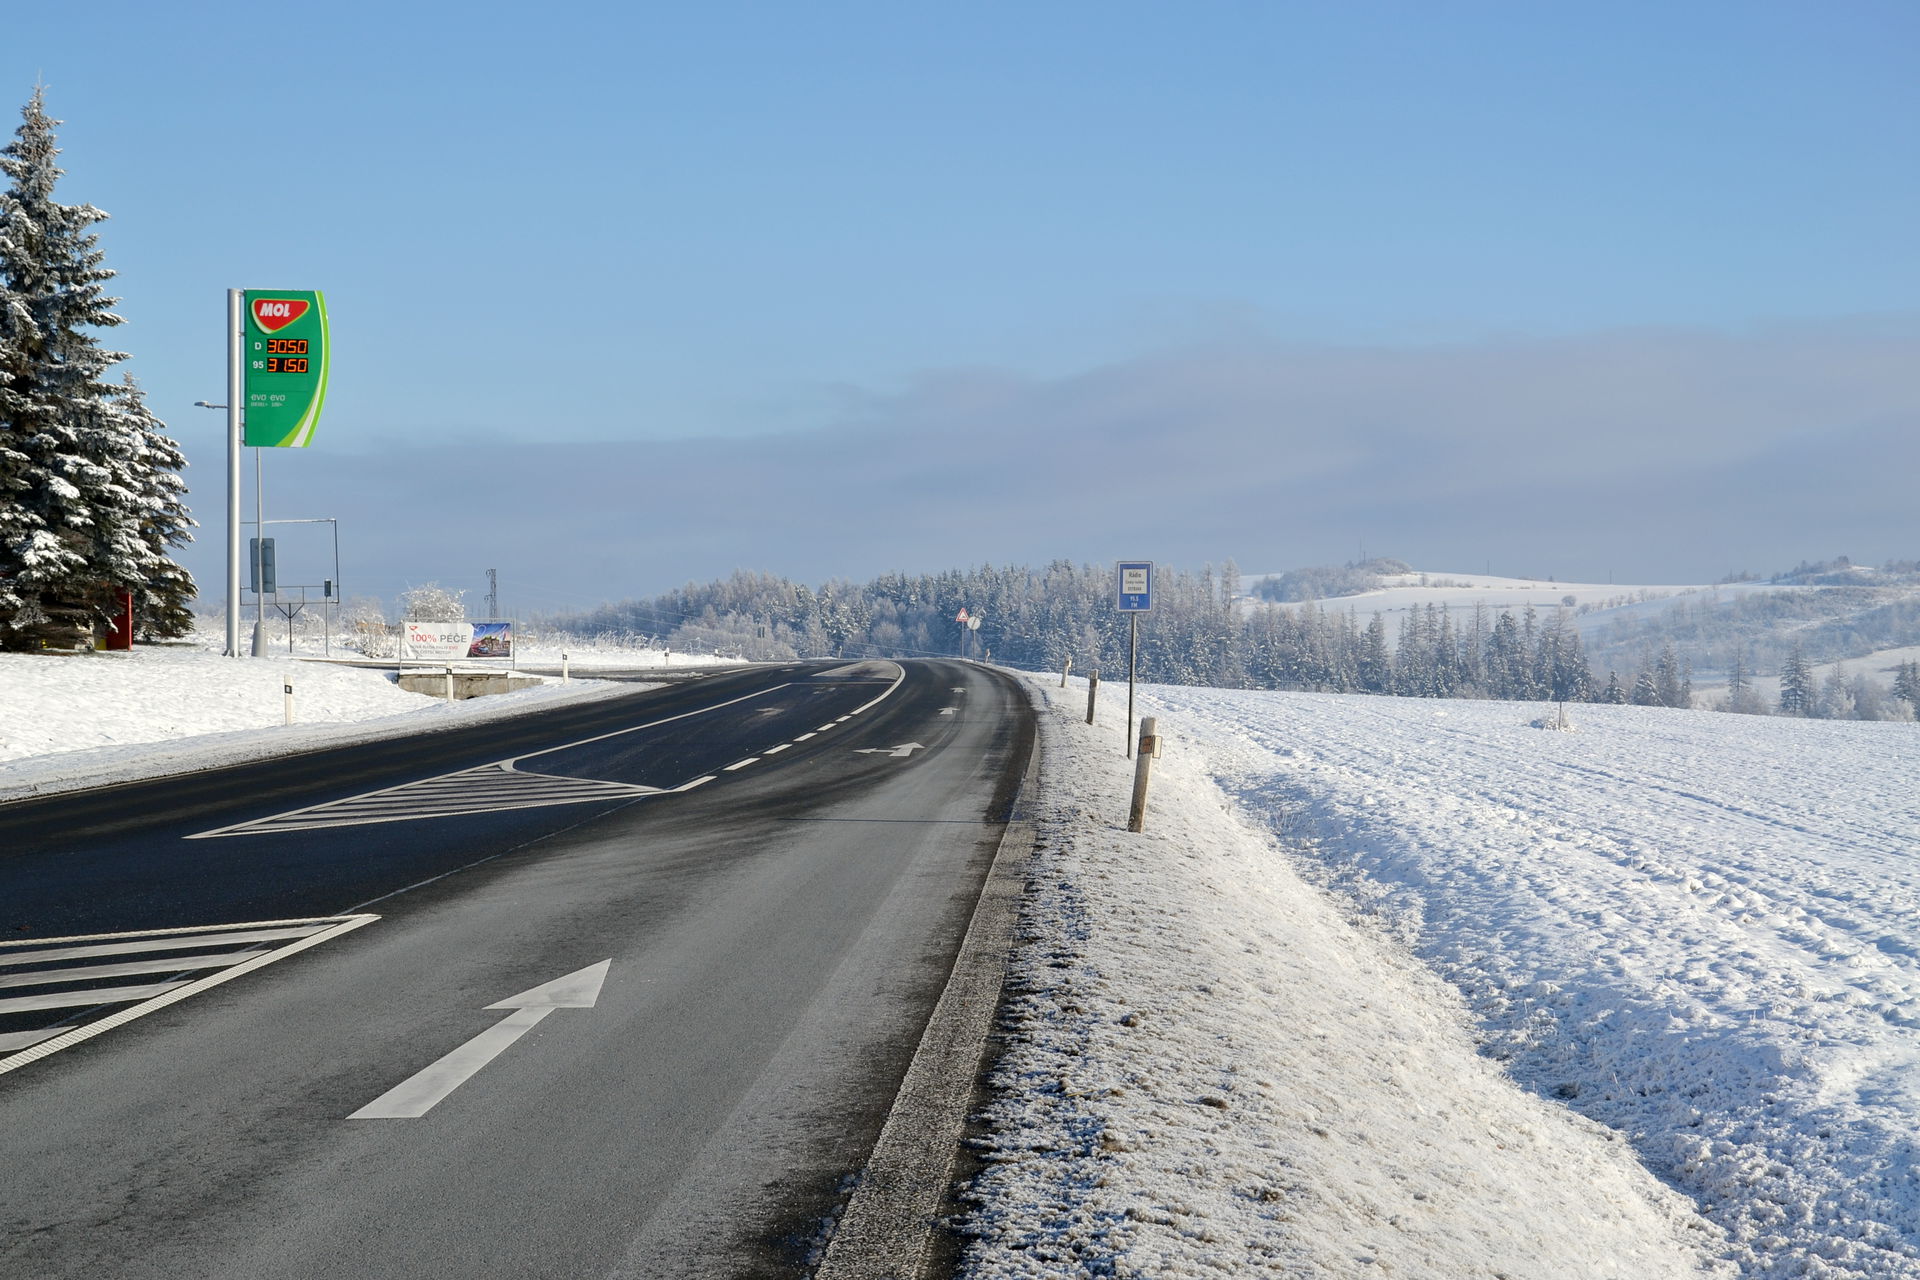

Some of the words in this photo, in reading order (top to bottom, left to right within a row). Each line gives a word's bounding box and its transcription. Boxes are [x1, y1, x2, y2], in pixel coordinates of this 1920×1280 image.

[260, 303, 291, 317] MOL
[254, 342, 262, 350] D
[252, 360, 264, 369] 95
[410, 634, 437, 643] 100%
[439, 633, 468, 643] PÉČE
